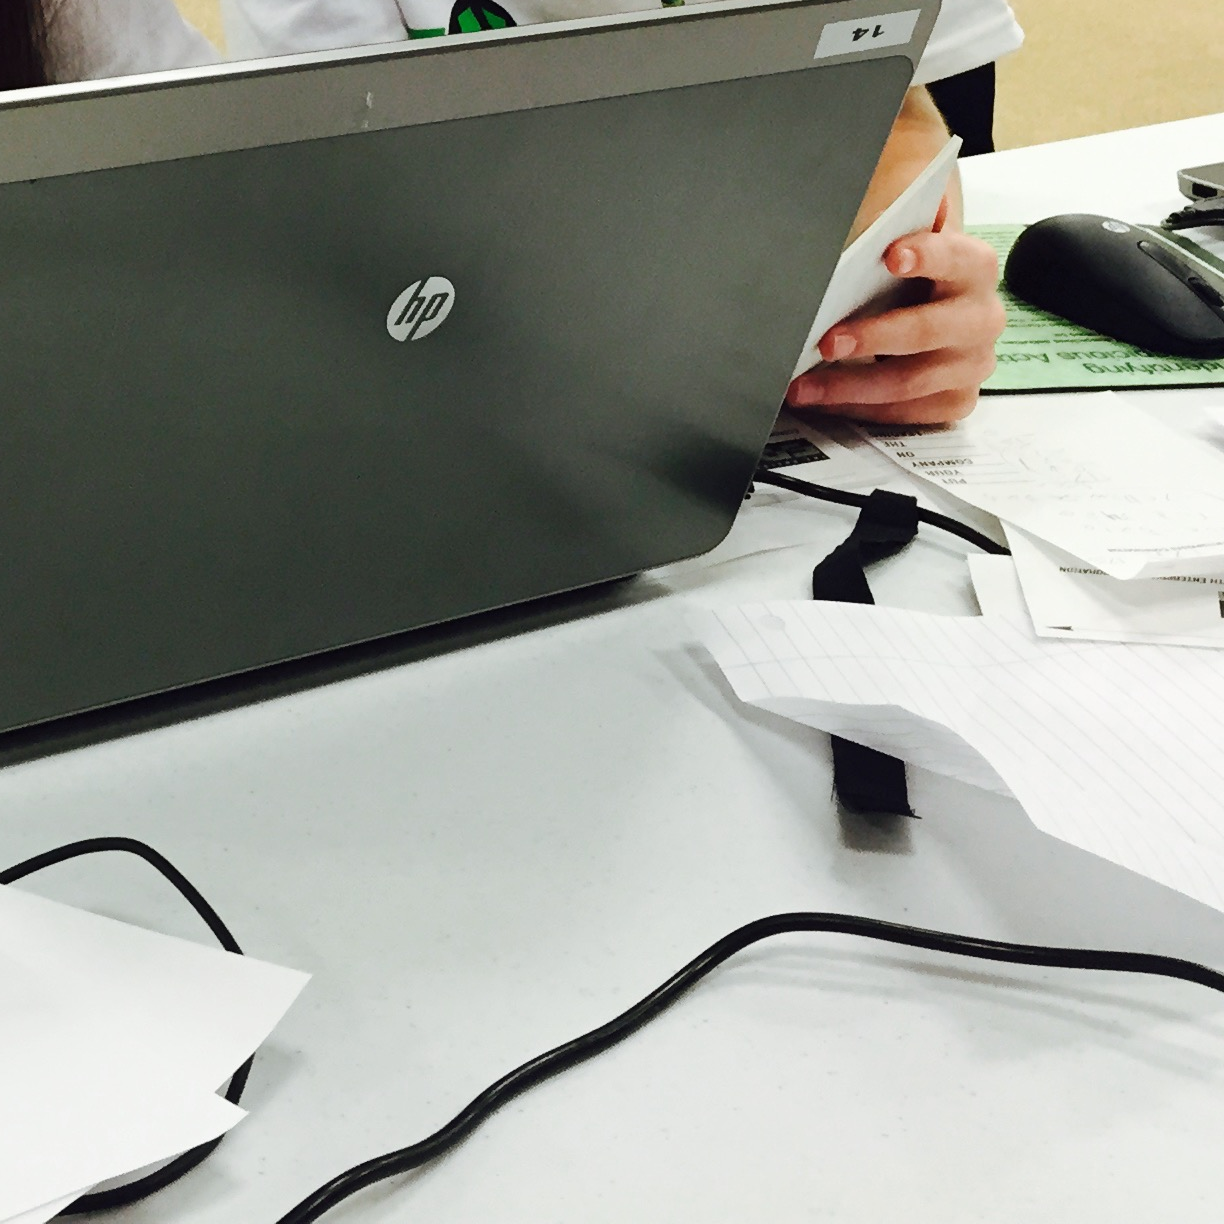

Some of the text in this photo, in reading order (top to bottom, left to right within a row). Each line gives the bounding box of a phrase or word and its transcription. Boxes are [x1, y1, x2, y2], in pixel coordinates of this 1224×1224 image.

[852, 25, 885, 42] 14
[390, 277, 452, 342] hp
[912, 458, 974, 468] COMPANY
[925, 469, 960, 477] YOUR
